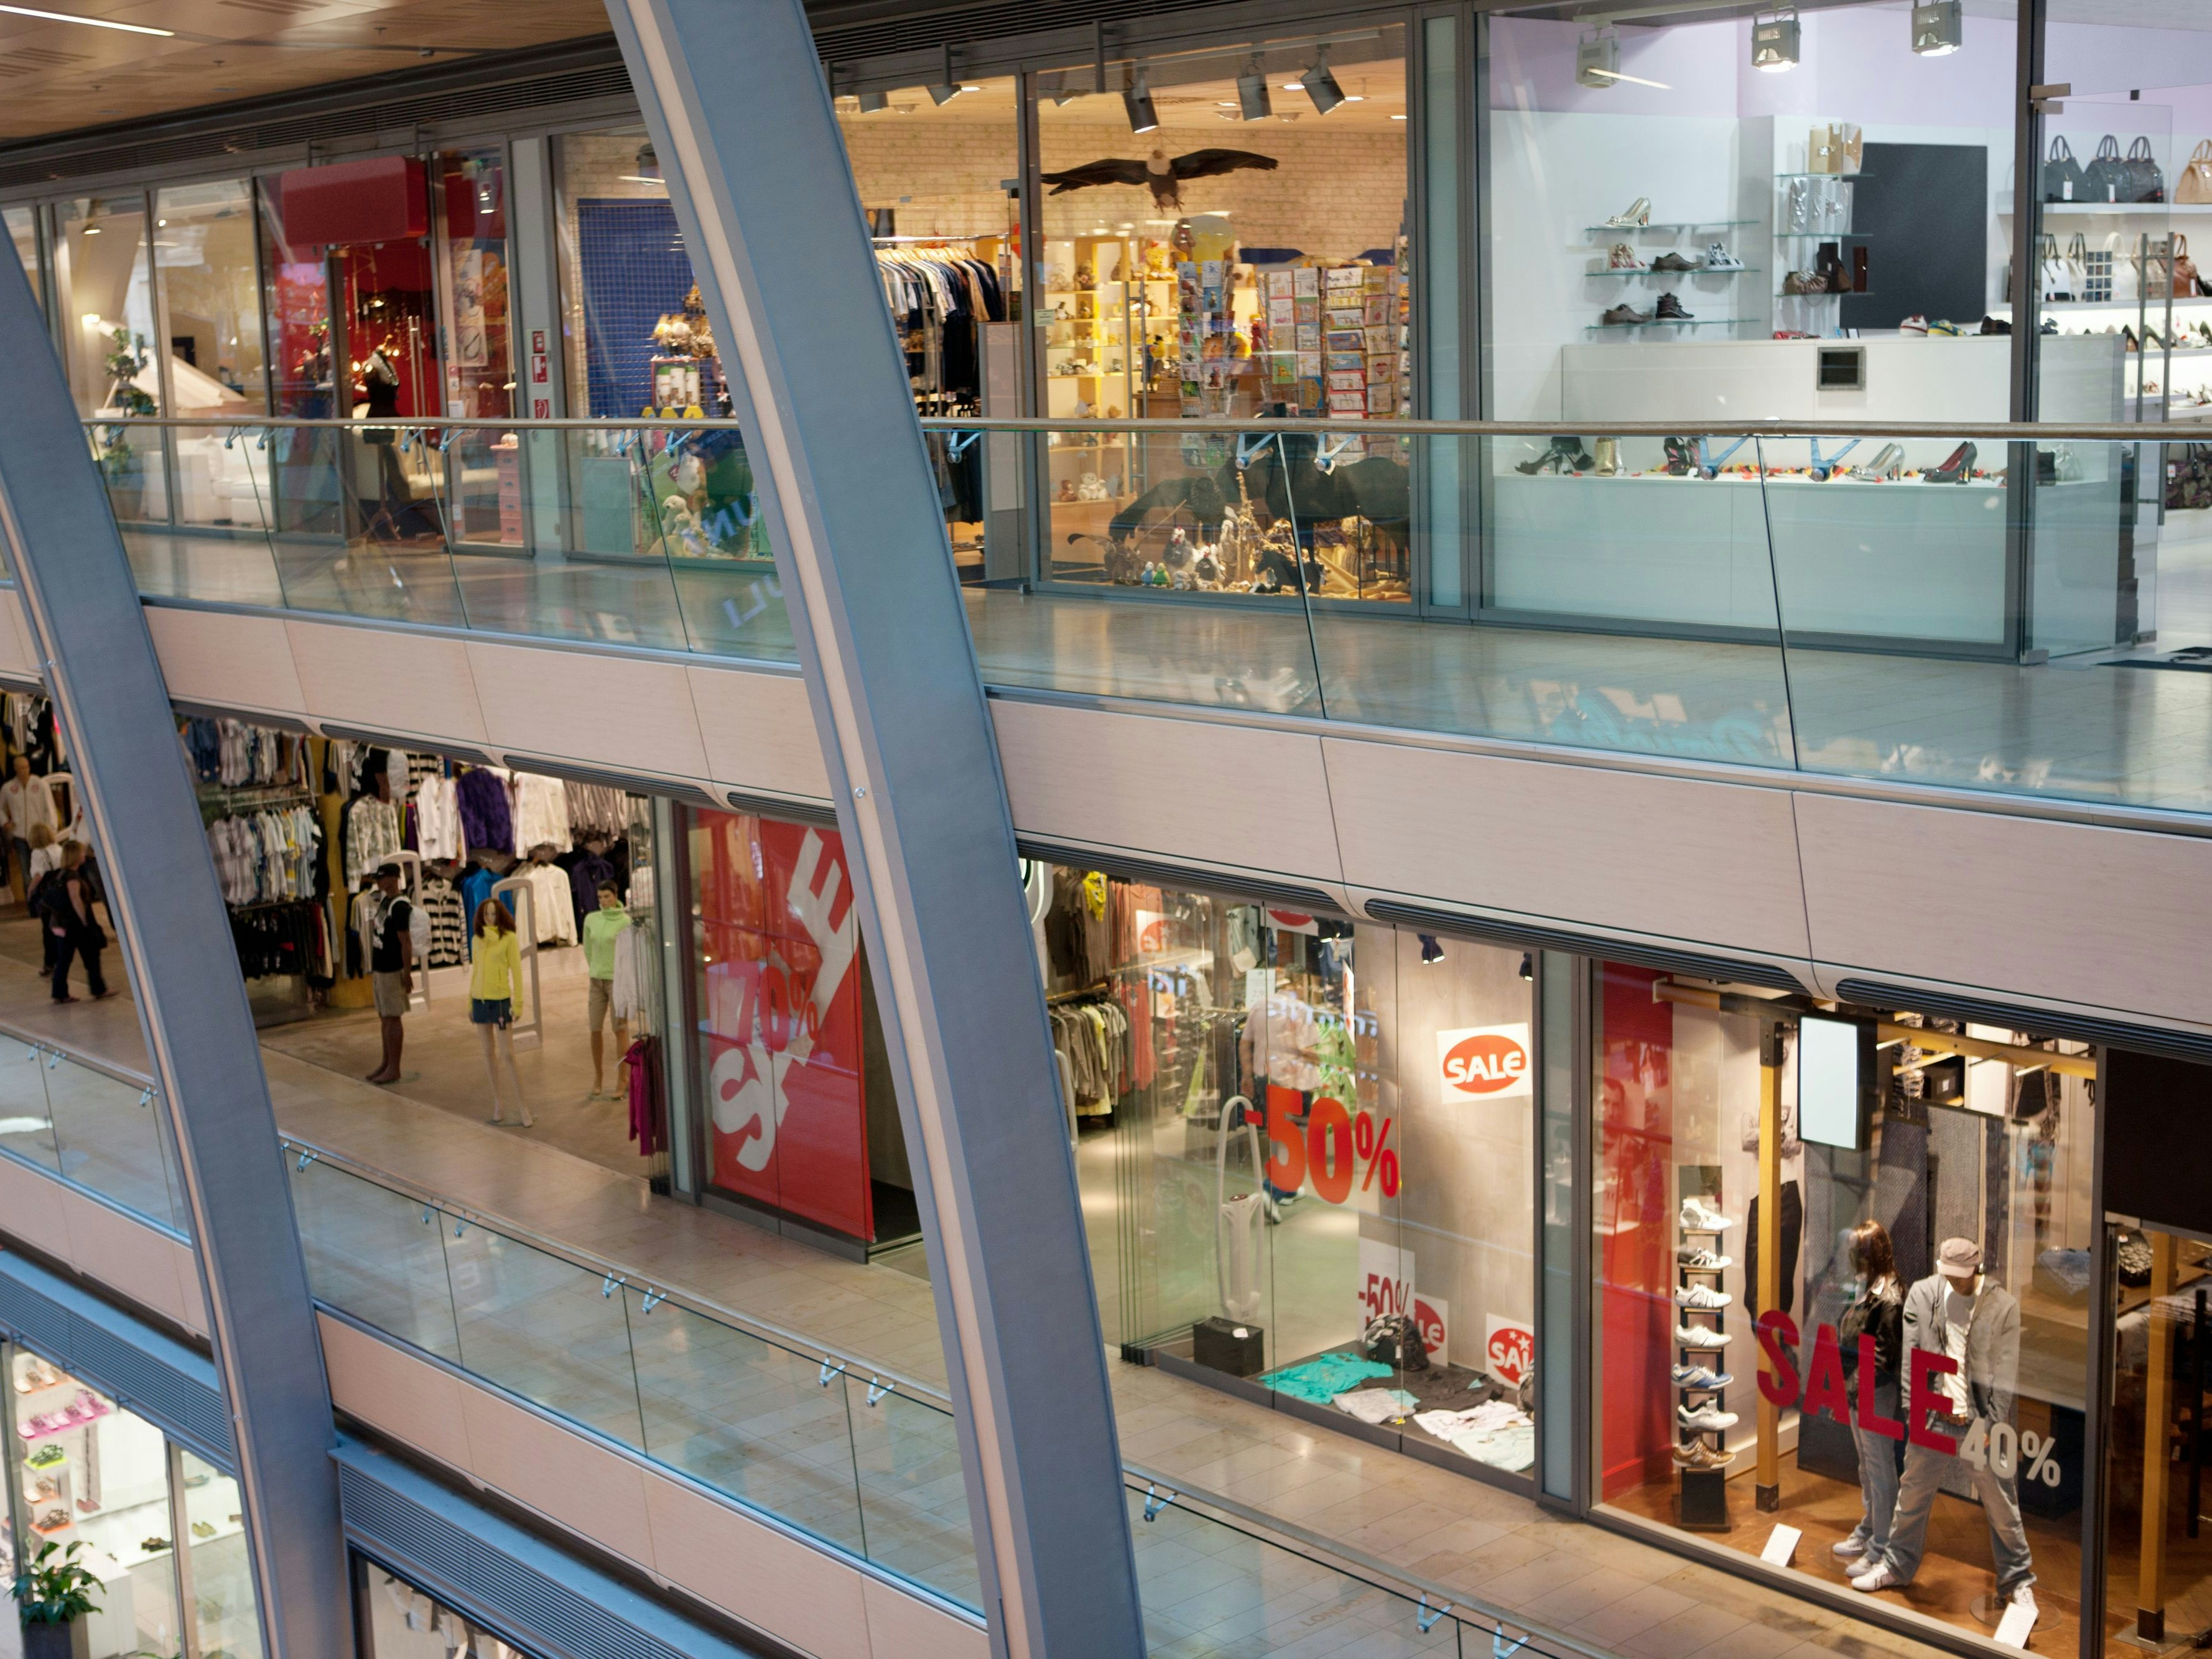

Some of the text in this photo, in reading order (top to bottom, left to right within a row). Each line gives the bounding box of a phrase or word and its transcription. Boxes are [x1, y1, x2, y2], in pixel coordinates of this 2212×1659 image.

[1445, 1050, 1525, 1085] SALE
[1245, 1084, 1398, 1204] -50%
[1757, 1310, 2061, 1487] SALE 40%
